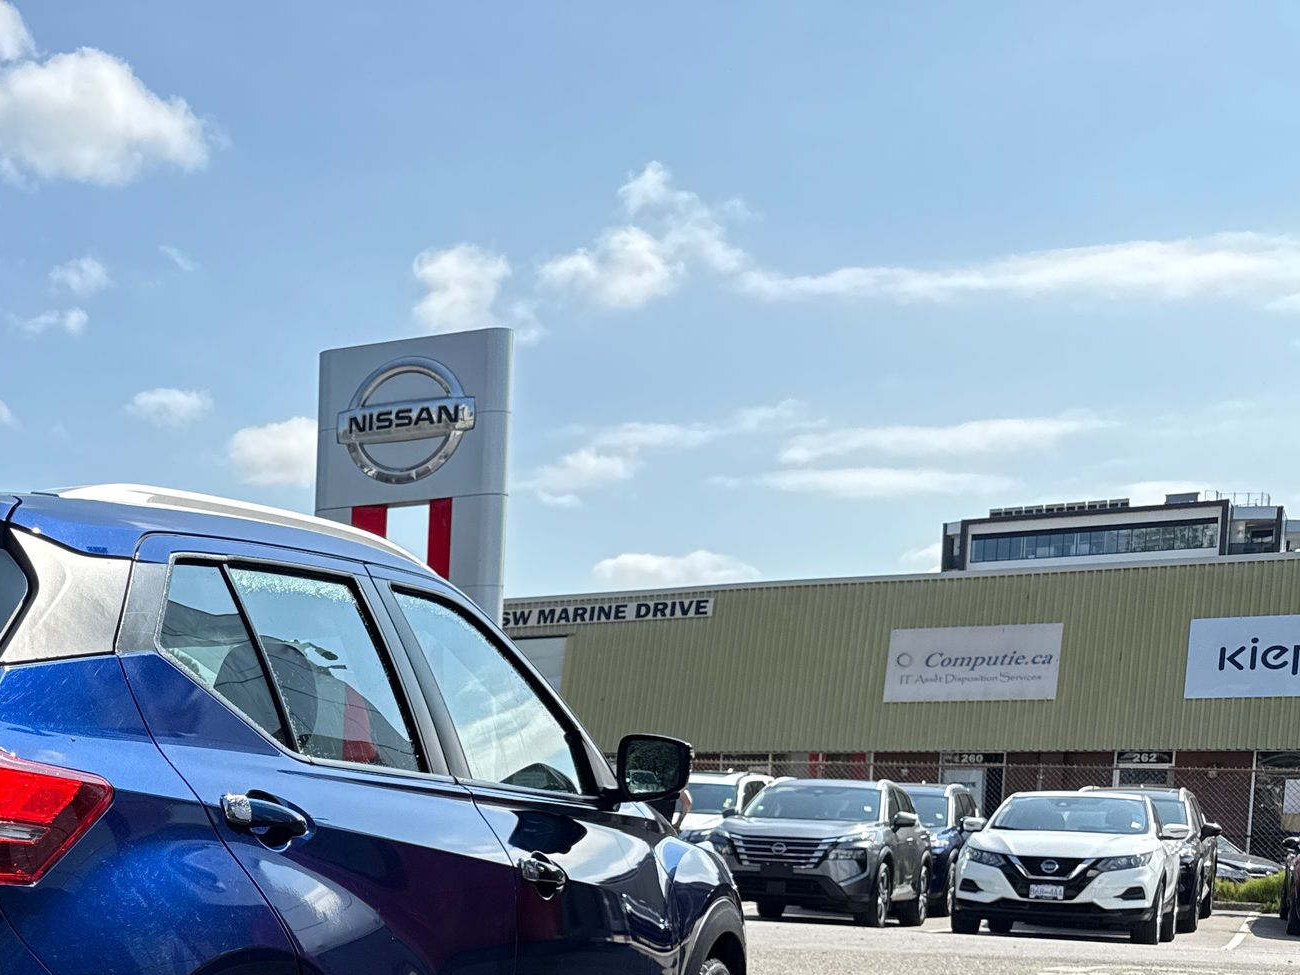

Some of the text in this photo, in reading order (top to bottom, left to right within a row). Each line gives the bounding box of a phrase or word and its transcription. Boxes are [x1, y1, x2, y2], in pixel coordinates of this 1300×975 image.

[349, 404, 460, 434] NISSAN
[503, 599, 710, 627] SW MARINE DRIVE
[925, 651, 1054, 672] Computie.ca
[899, 674, 913, 685] IT
[944, 674, 999, 686] Disposition
[999, 671, 1043, 683] Services
[960, 753, 984, 763] 260
[1132, 753, 1157, 763] 262
